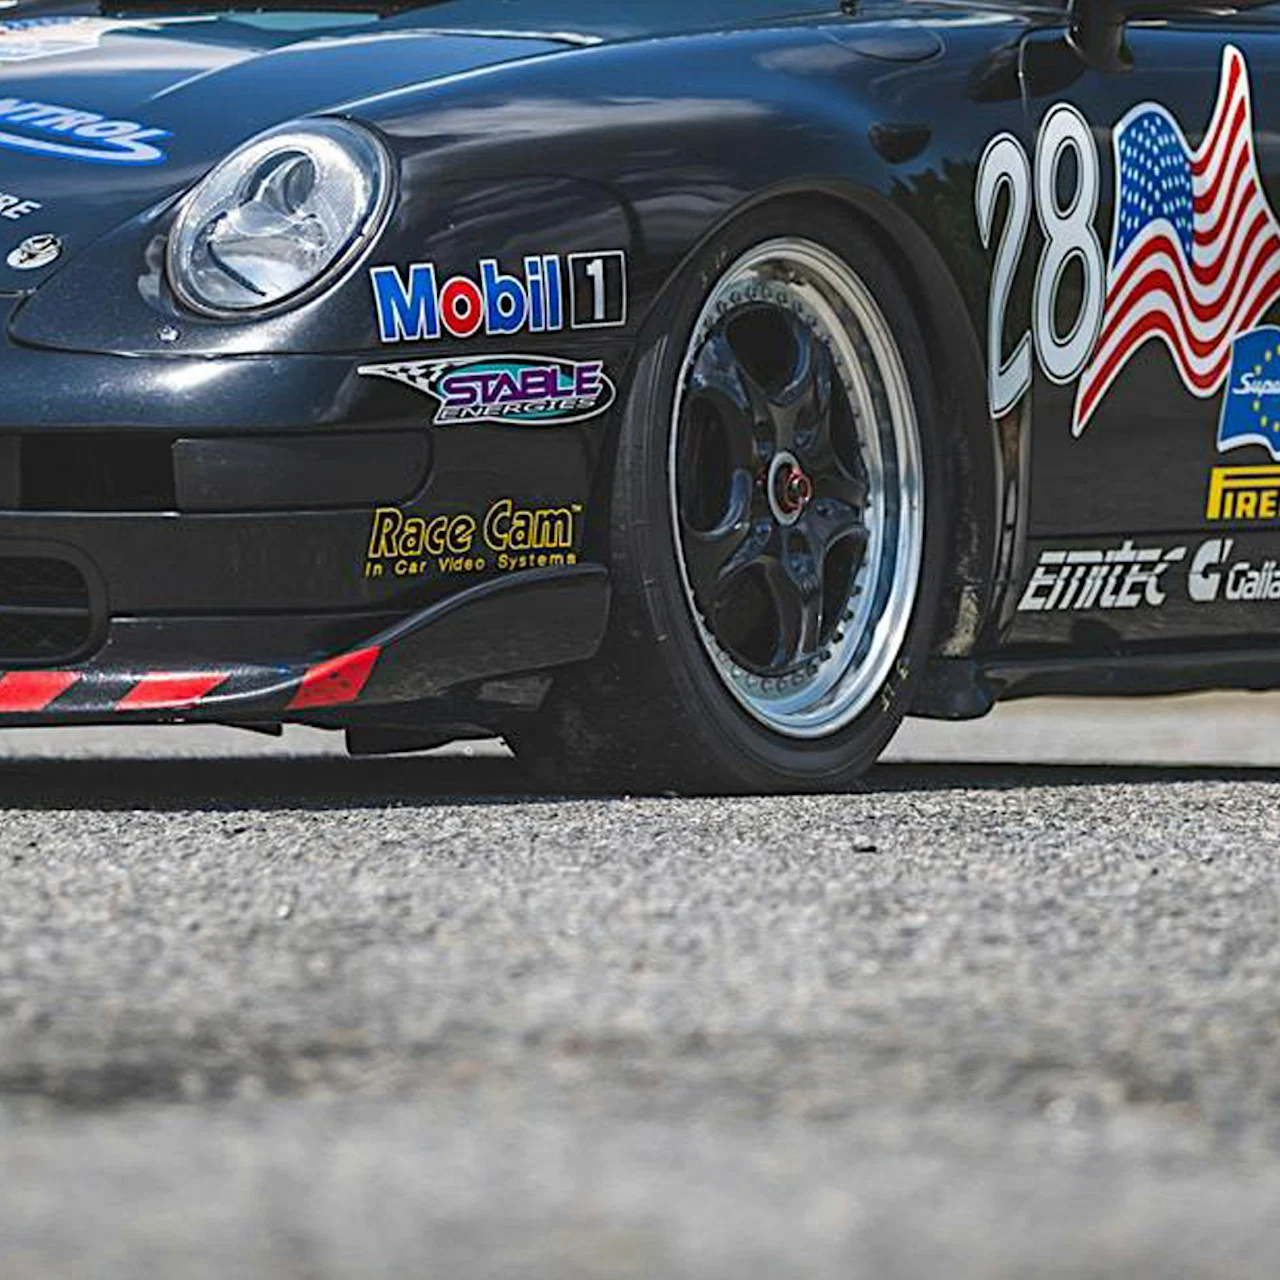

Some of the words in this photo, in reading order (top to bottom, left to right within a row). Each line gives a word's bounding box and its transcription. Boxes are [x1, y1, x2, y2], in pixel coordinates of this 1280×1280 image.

[975, 102, 1106, 420] 28
[370, 255, 562, 343] Mobil
[439, 361, 604, 407] STABLE
[440, 398, 597, 419] ENERGIES
[368, 507, 476, 558] Race
[366, 561, 382, 576] In
[394, 559, 427, 575] Car
[438, 556, 486, 572] Video
[497, 552, 577, 570] Systems
